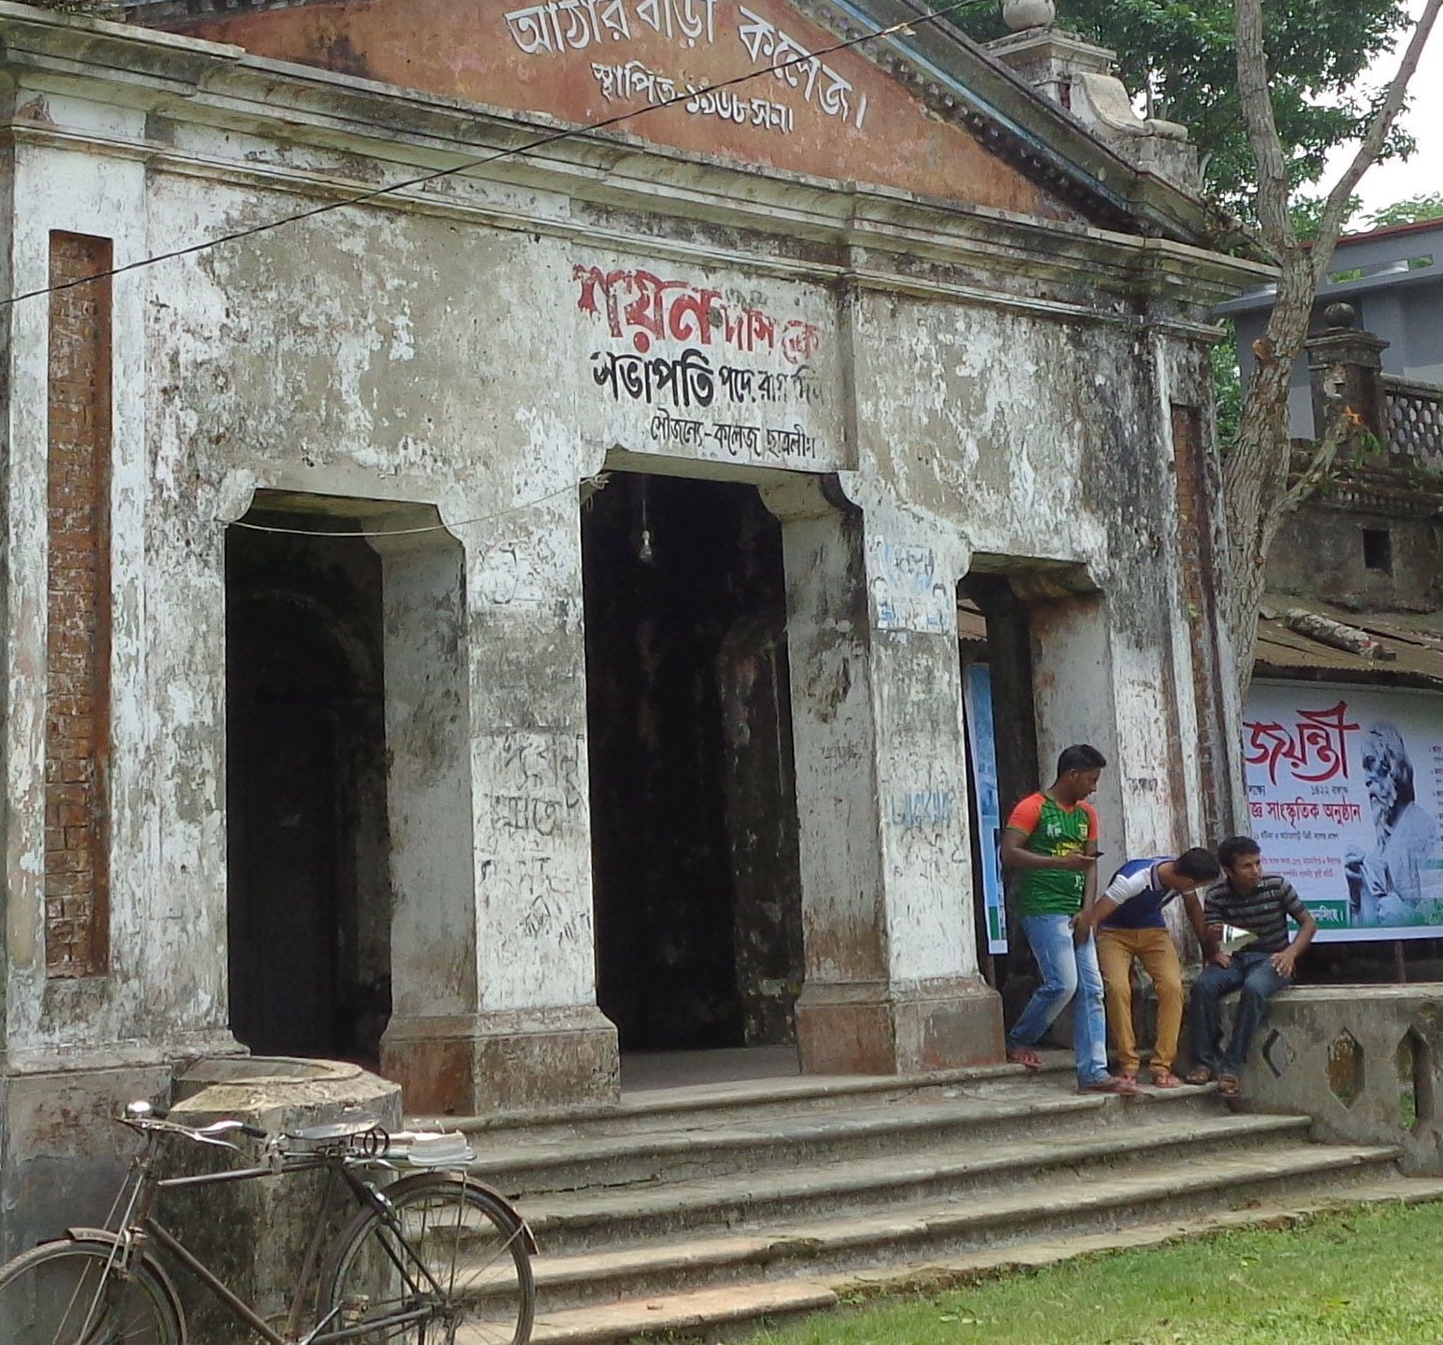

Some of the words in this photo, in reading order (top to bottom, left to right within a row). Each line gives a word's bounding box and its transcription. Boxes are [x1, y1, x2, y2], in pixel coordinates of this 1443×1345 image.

[590, 348, 714, 407] সভাপতি
[719, 365, 756, 404] পদে
[1242, 700, 1360, 786] জয়ন্তী
[1266, 796, 1320, 829] সাংস্কৃতিক
[1322, 794, 1362, 826] অনুষ্ঠান
